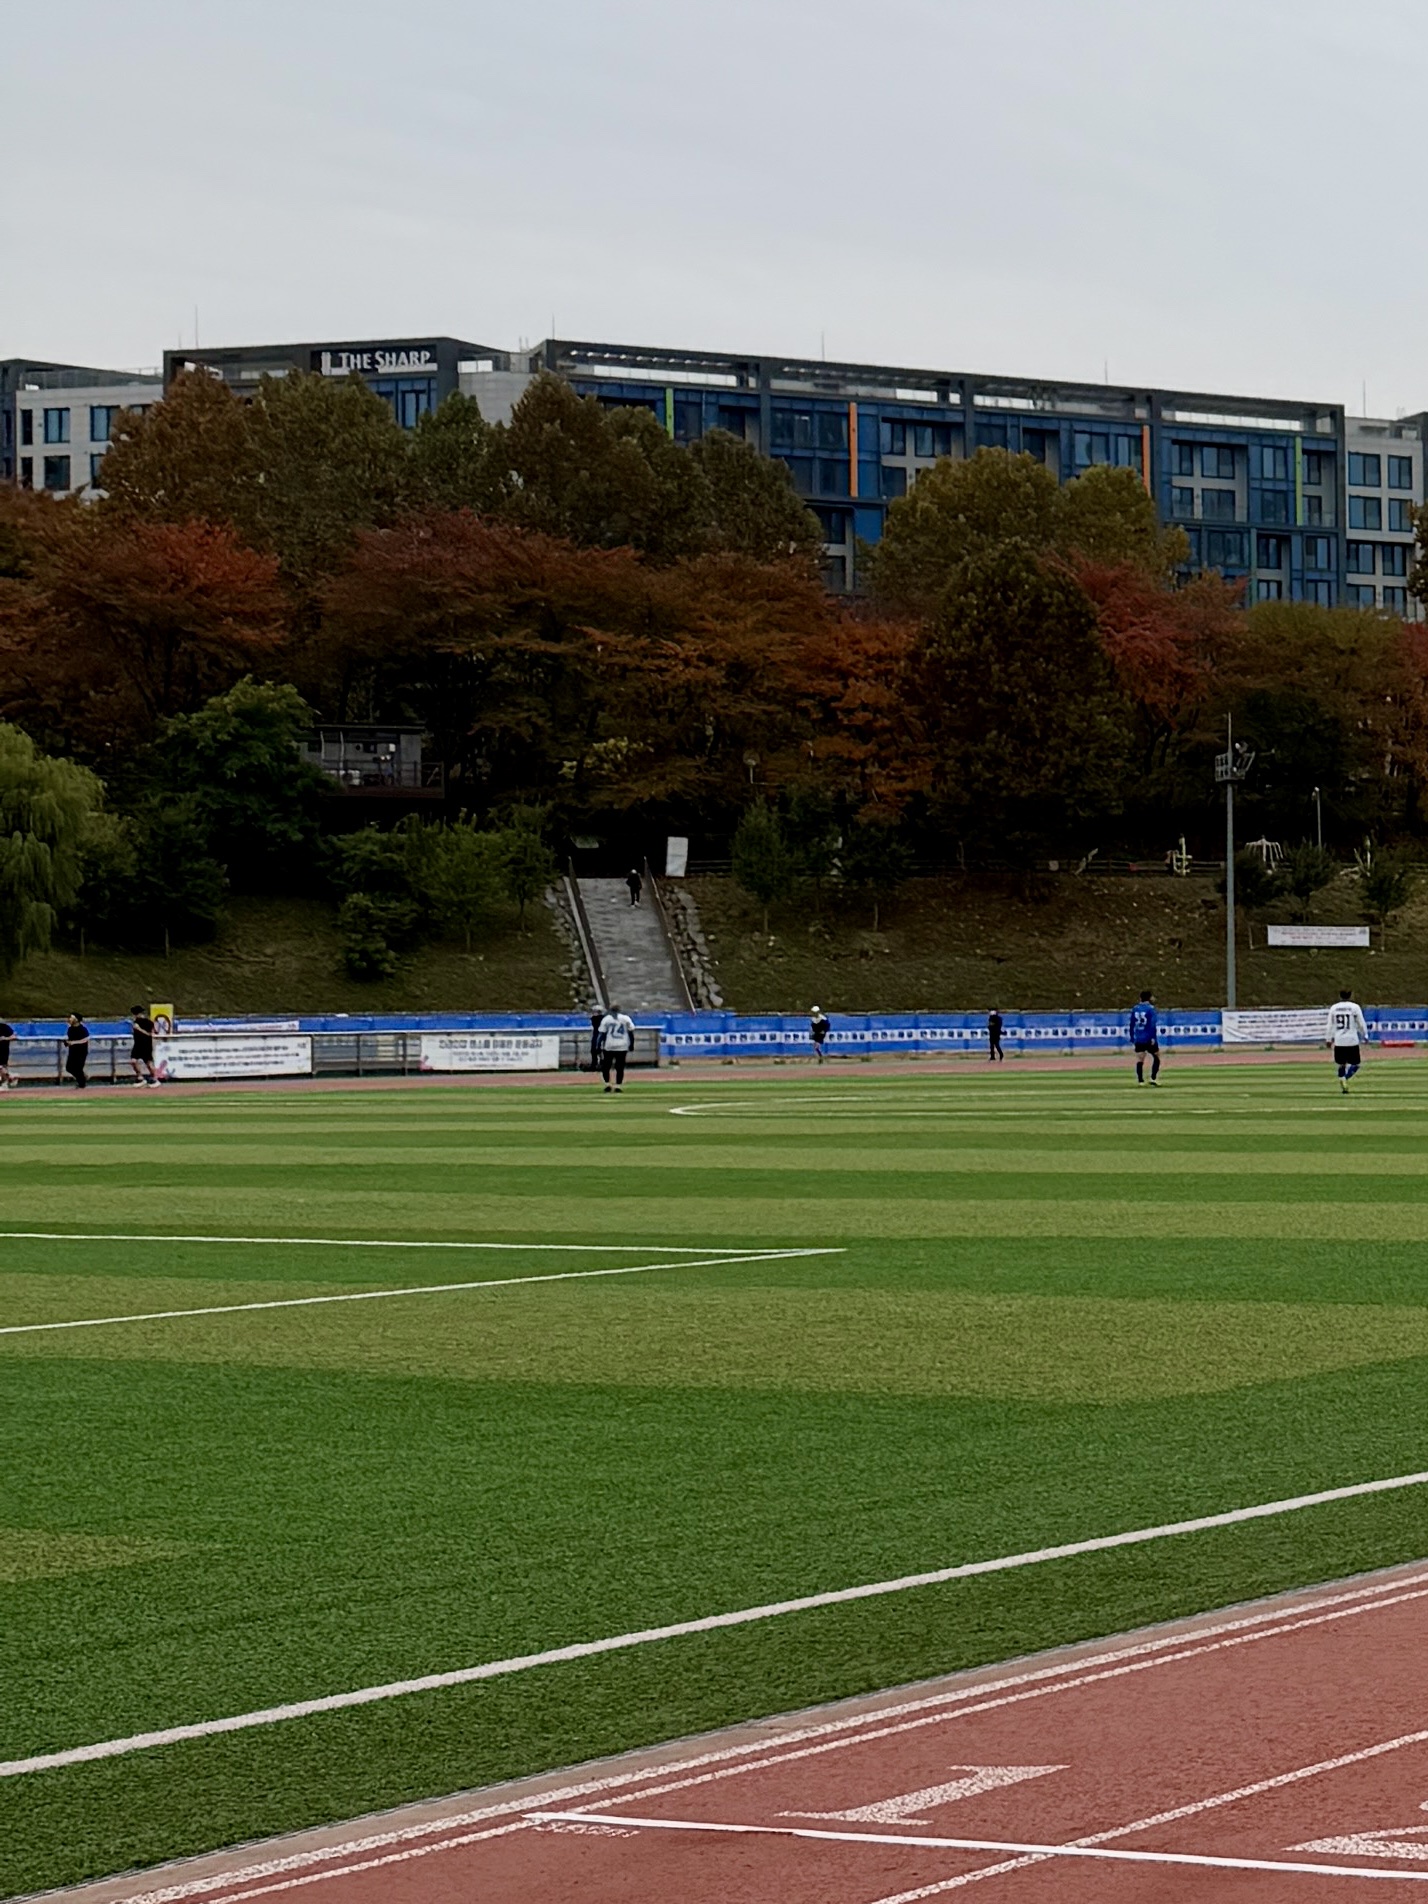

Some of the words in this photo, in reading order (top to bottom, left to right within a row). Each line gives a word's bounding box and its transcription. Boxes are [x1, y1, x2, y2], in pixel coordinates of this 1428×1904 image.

[338, 352, 372, 370] THE
[374, 350, 431, 369] SHARP
[773, 1764, 1071, 1826] 1
